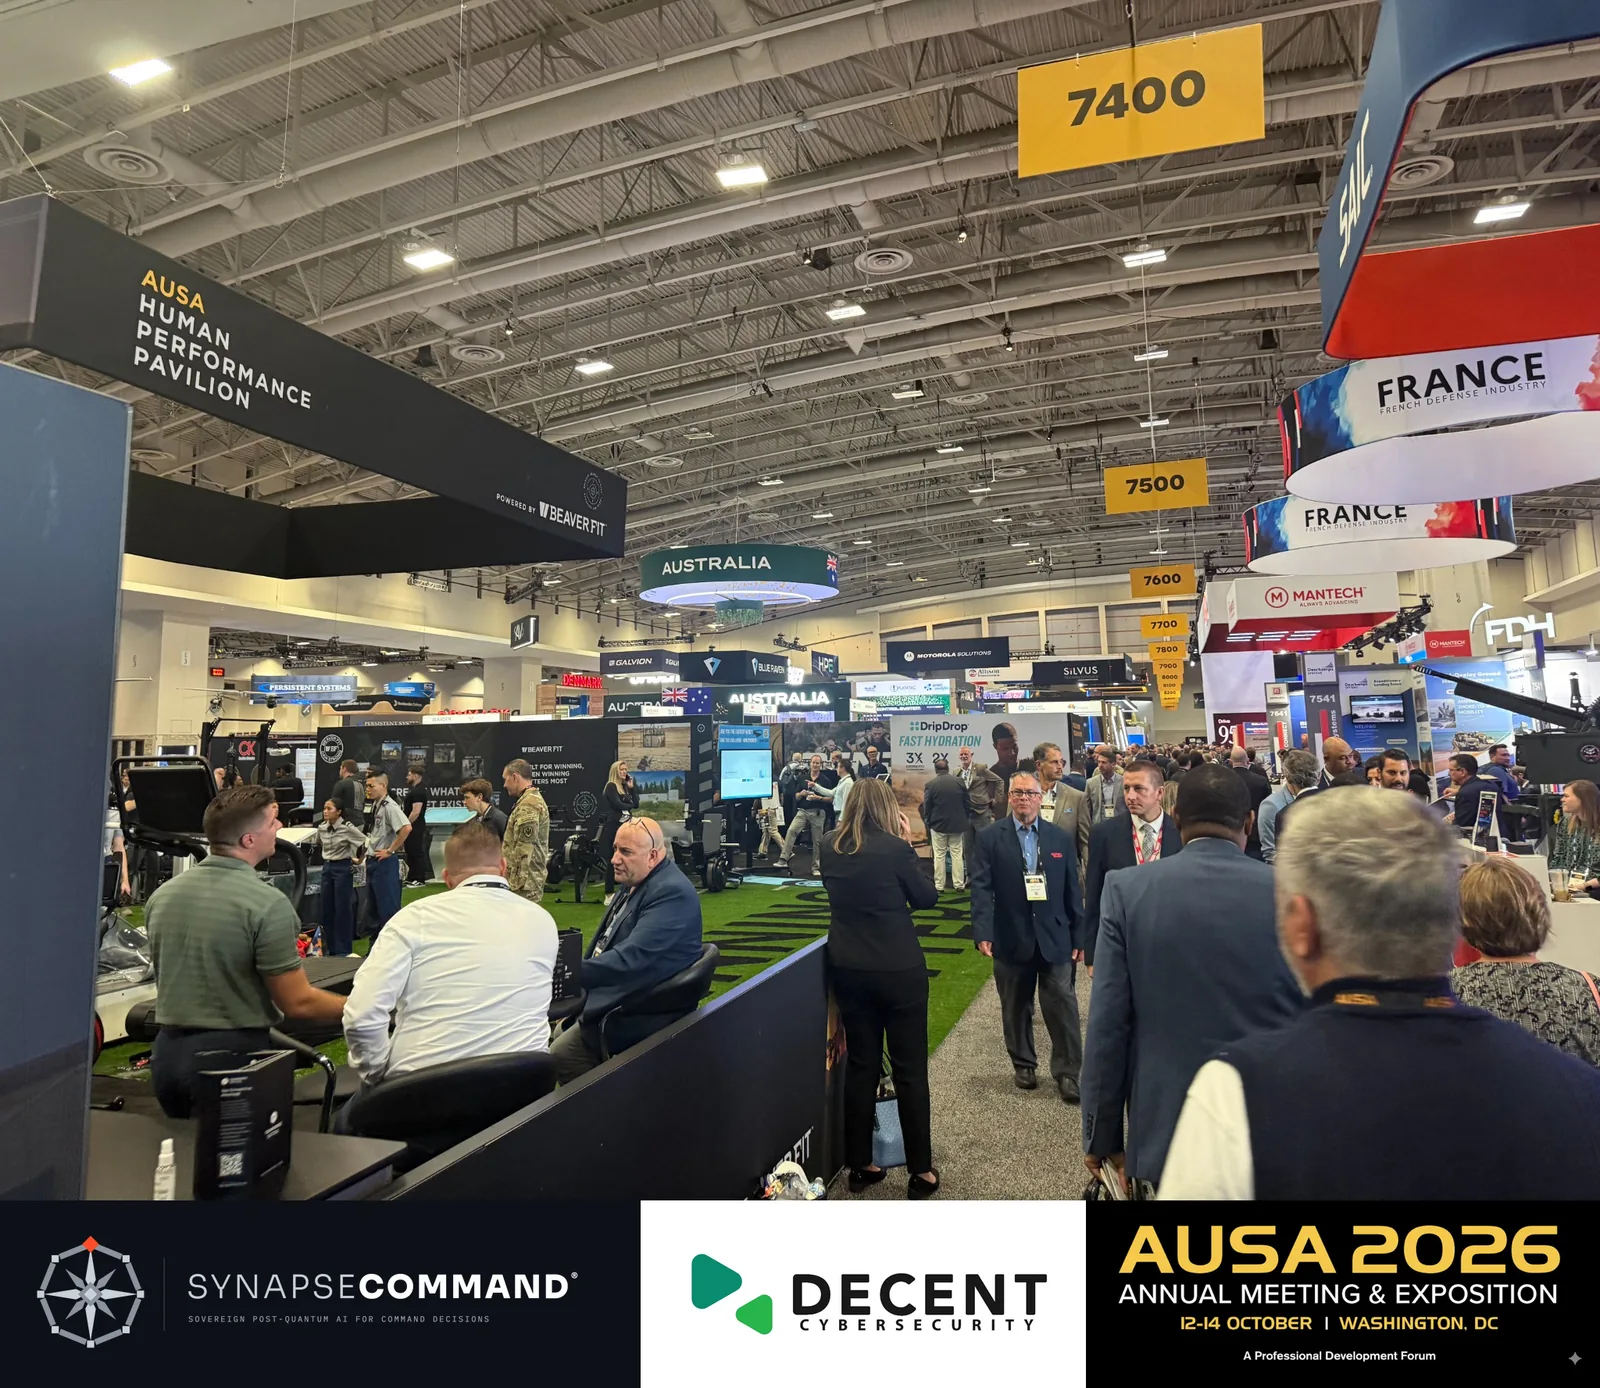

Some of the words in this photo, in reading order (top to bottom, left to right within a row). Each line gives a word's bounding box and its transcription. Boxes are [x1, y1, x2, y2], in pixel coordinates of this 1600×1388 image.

[1067, 69, 1206, 127] 7400
[1339, 107, 1372, 269] SAIC
[141, 269, 205, 314] AUSA
[139, 293, 230, 351] HUMAN
[137, 319, 312, 409] PERFORMANCE
[133, 345, 250, 410] PAVILION
[1377, 352, 1546, 408] FRANCE
[1380, 399, 1421, 416] FRENCH
[1426, 389, 1479, 406] DEFENSE
[1485, 380, 1546, 396] INDUSTRY
[1125, 474, 1185, 495] 7500
[496, 492, 527, 511] POWERED
[528, 505, 536, 514] BY
[1305, 505, 1408, 527] FRANCE
[1305, 525, 1332, 533] FRENCH
[1334, 521, 1366, 530] DEFENSE
[1369, 518, 1408, 526] INDUSTRY
[661, 555, 772, 576] AUSTRALIA
[1143, 573, 1181, 586] 7600
[1150, 620, 1178, 630] 7700
[1484, 611, 1557, 646] FDH
[615, 658, 652, 666] GALVION
[758, 662, 771, 673] BLUE
[771, 663, 785, 674] RAVEN
[818, 656, 834, 673] HPE
[269, 684, 315, 692] PERSISTENT
[562, 673, 603, 689] DENMARK
[729, 691, 830, 706] AUSTRALIA
[1309, 694, 1336, 703] 7541
[920, 721, 968, 732] DripDrop
[898, 735, 923, 747] FAST
[924, 735, 982, 747] HYDRATION
[906, 752, 923, 764] 3X
[430, 786, 460, 796] WHAT
